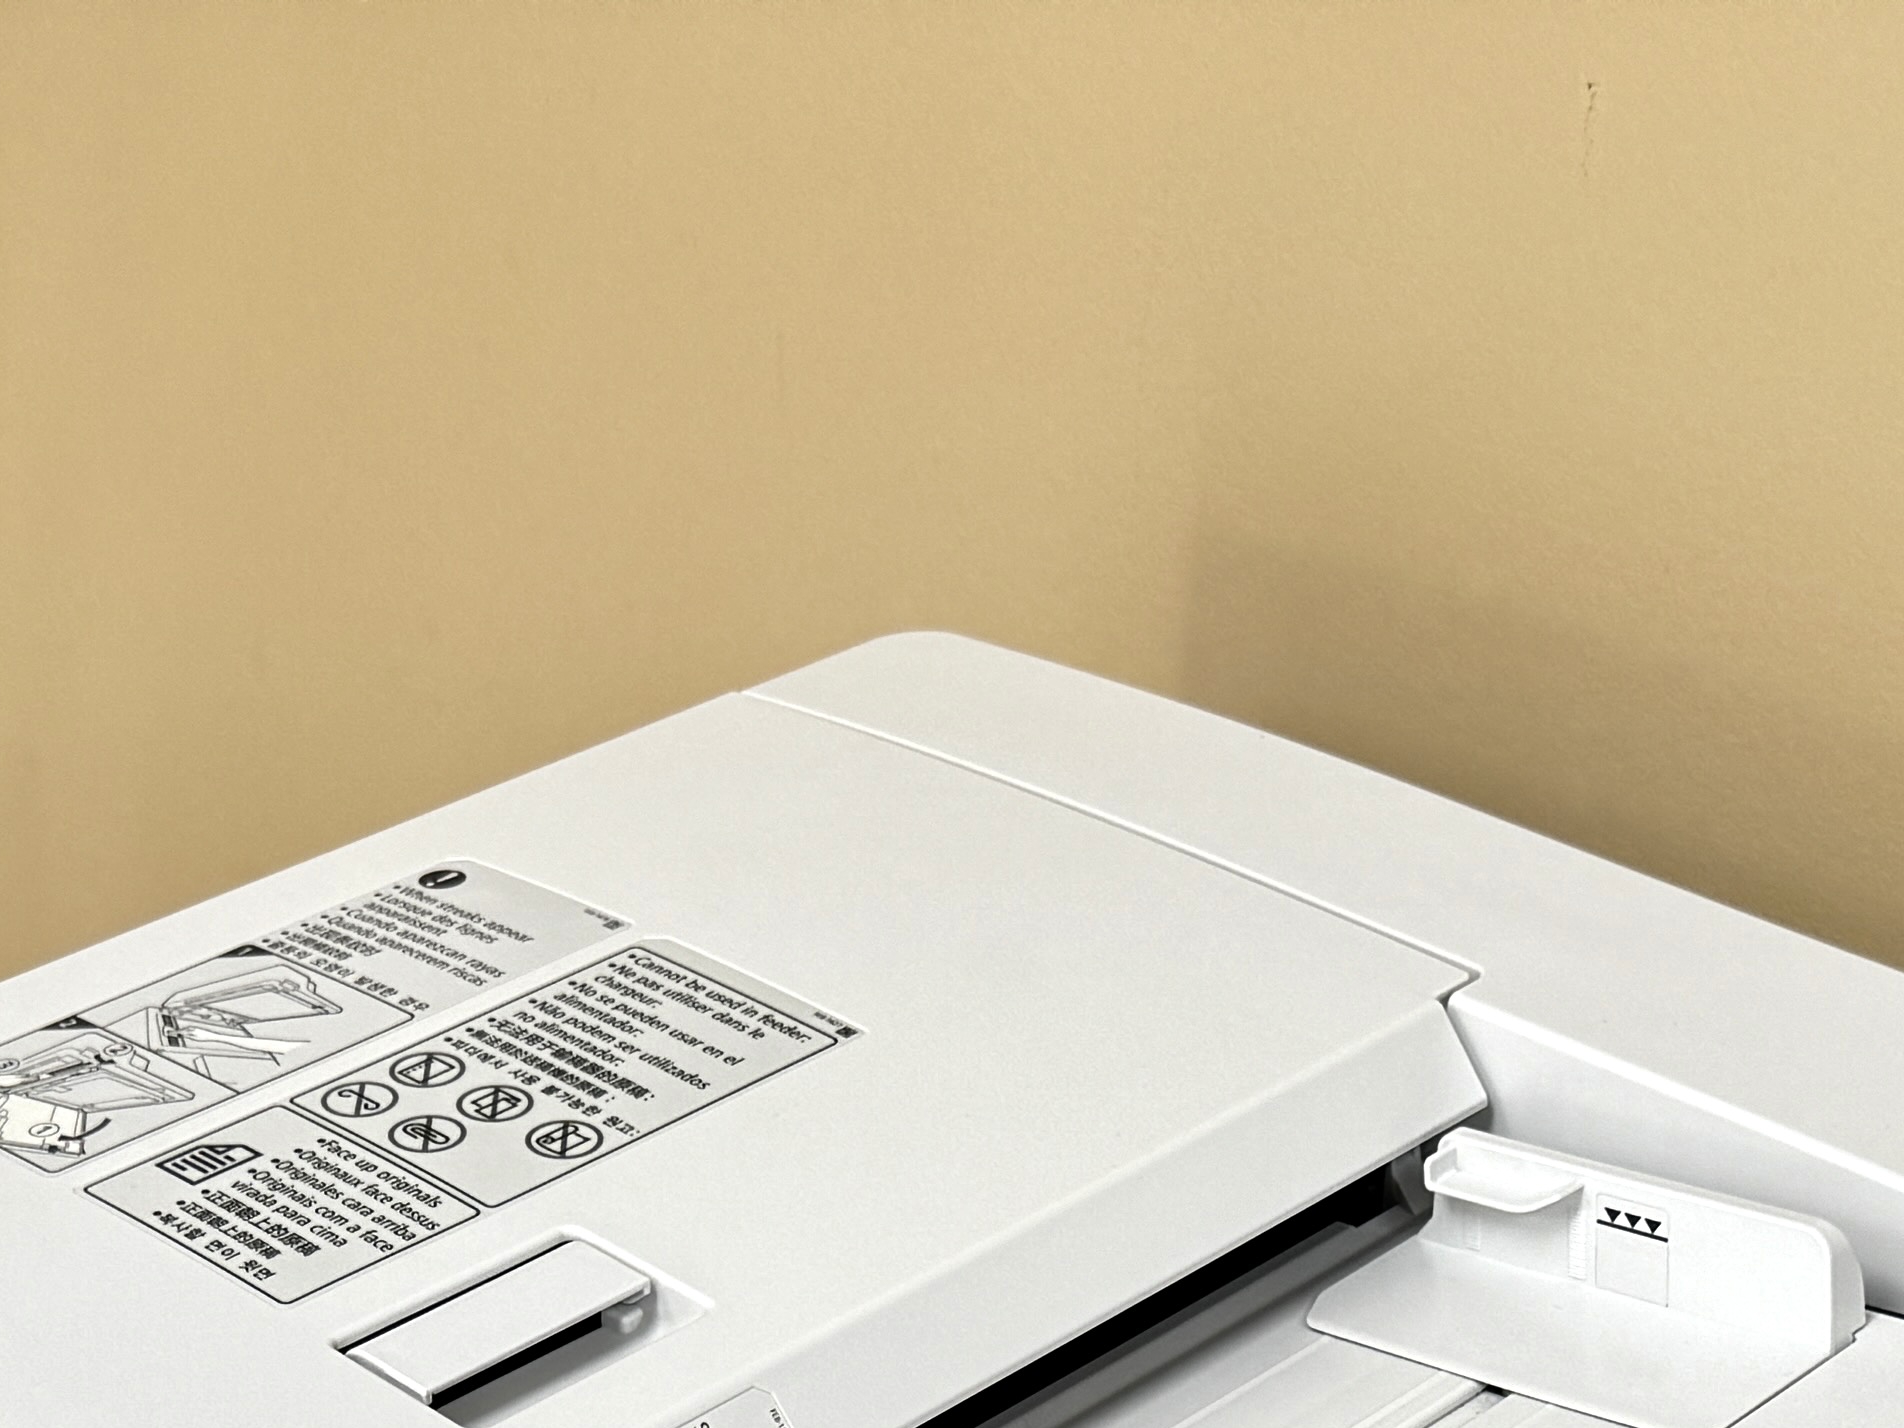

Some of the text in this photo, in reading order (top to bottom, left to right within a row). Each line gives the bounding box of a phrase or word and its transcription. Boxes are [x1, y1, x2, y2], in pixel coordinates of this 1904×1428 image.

[512, 1011, 535, 1023] no
[573, 982, 745, 1066] No se pueden usar en el
[612, 964, 765, 1039] Ne pas utiliser dans le
[634, 957, 687, 983] Cannot
[684, 979, 706, 992] be
[704, 990, 746, 1010] used
[740, 1005, 758, 1018] in
[533, 1000, 710, 1089] Não podem ser utilizados
[252, 1170, 393, 1252] Originais com a face
[275, 1160, 416, 1241] Originales cara arriba
[298, 1150, 440, 1230] Originaux face dessus
[320, 1139, 442, 1208] Face up originals
[230, 1180, 347, 1247] virada para cima
